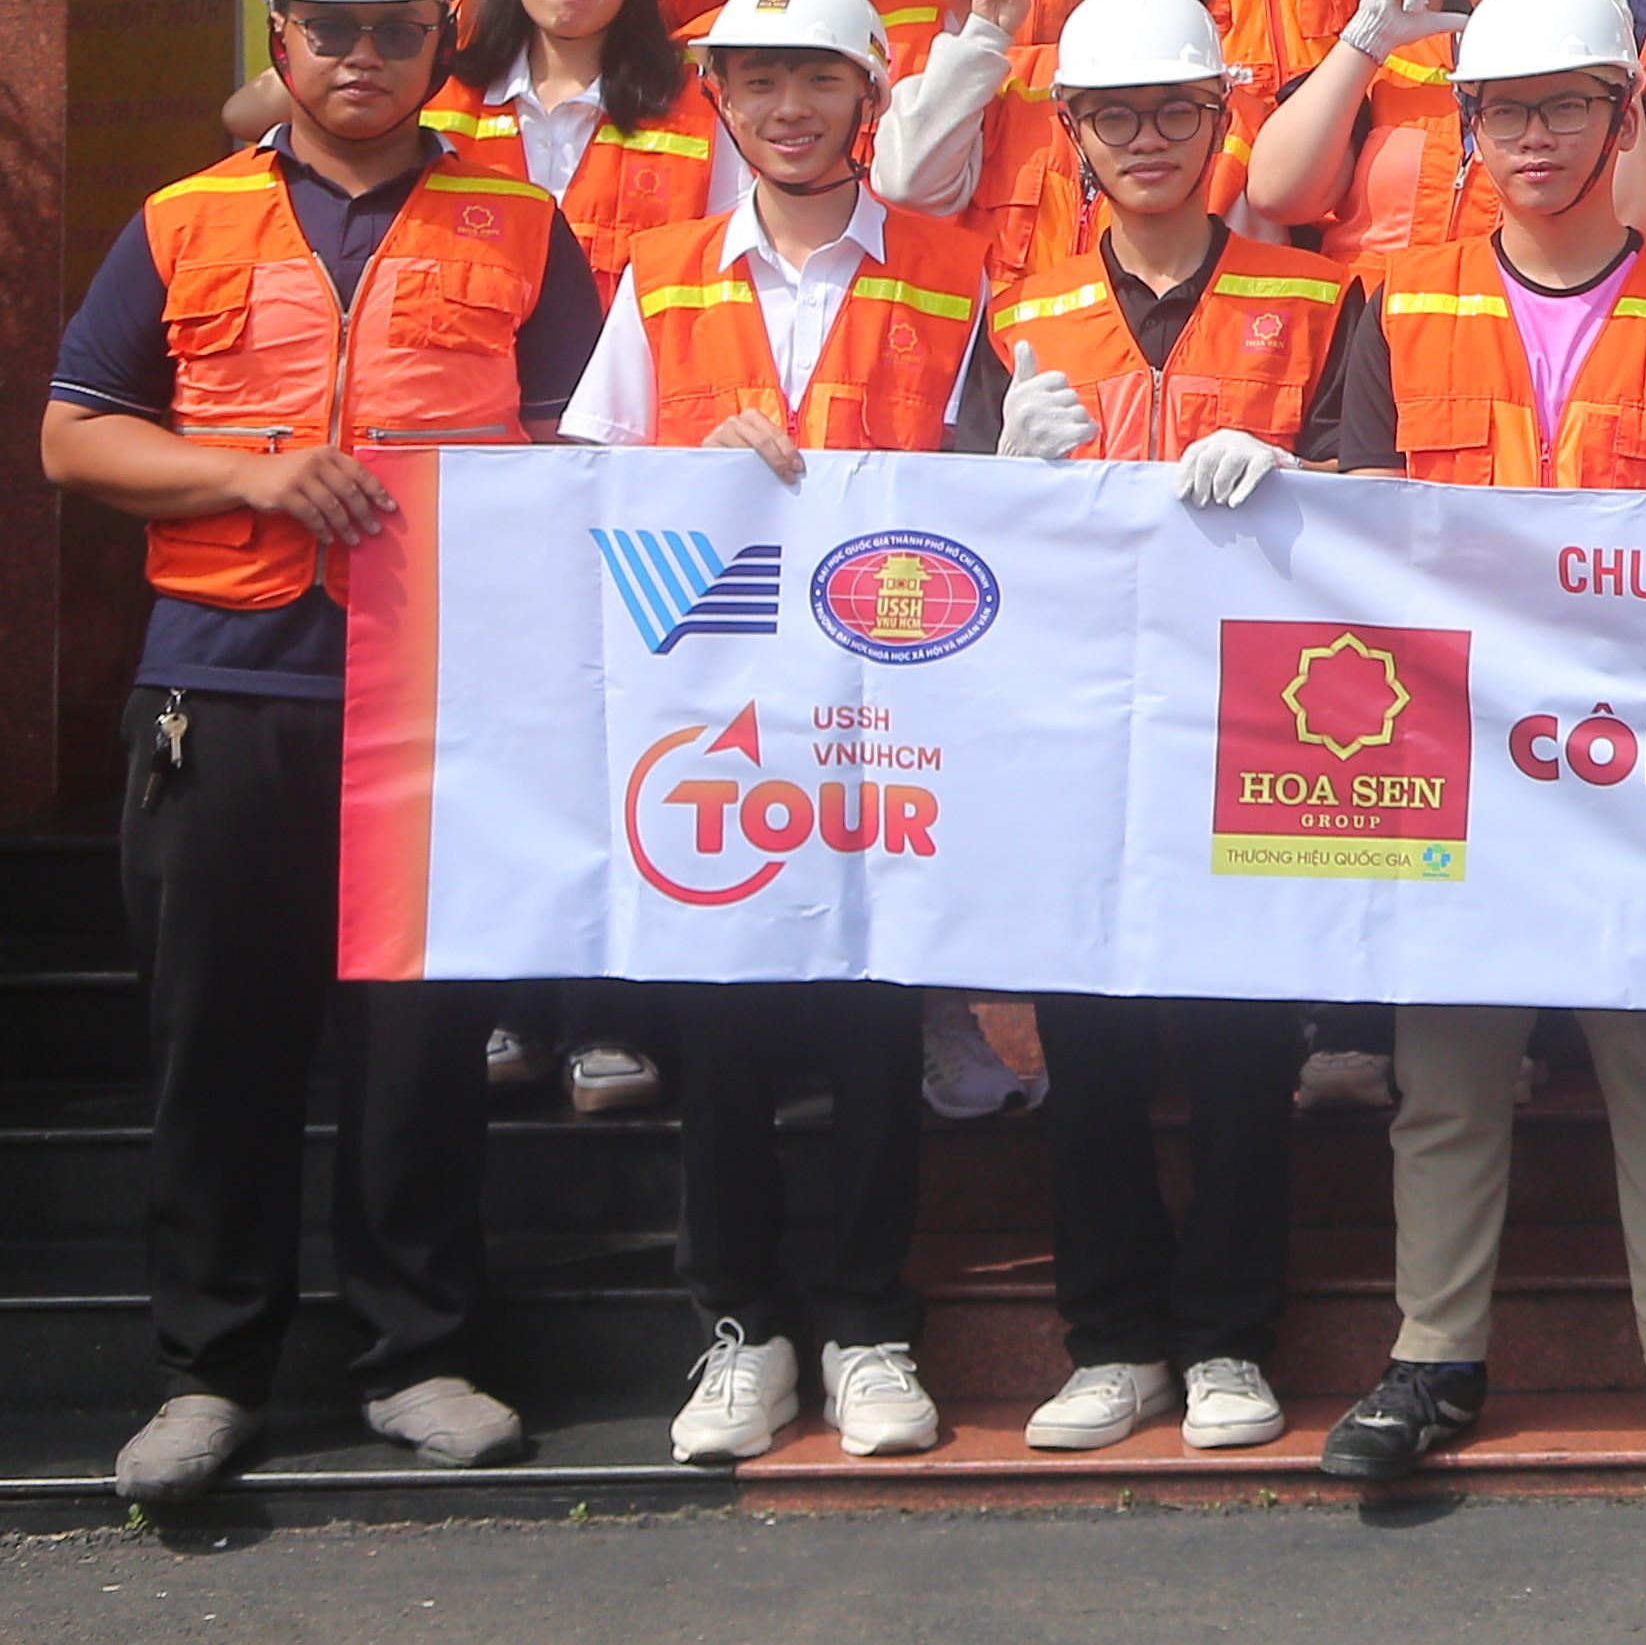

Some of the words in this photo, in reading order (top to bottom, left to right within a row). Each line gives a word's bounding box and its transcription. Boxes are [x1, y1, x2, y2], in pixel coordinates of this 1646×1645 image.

[873, 536, 889, 547] GIA
[876, 597, 923, 617] USSH
[876, 617, 897, 629] VNU
[899, 617, 922, 630] HCM
[812, 706, 891, 732] USSH
[812, 742, 942, 771] VNUHCM
[1238, 771, 1340, 806] HOA
[1351, 774, 1447, 809] SEN
[1300, 813, 1381, 830] GROUP
[1296, 849, 1332, 867] HIỆU
[1334, 847, 1383, 868] QUỐC
[1385, 853, 1412, 868] GIA
